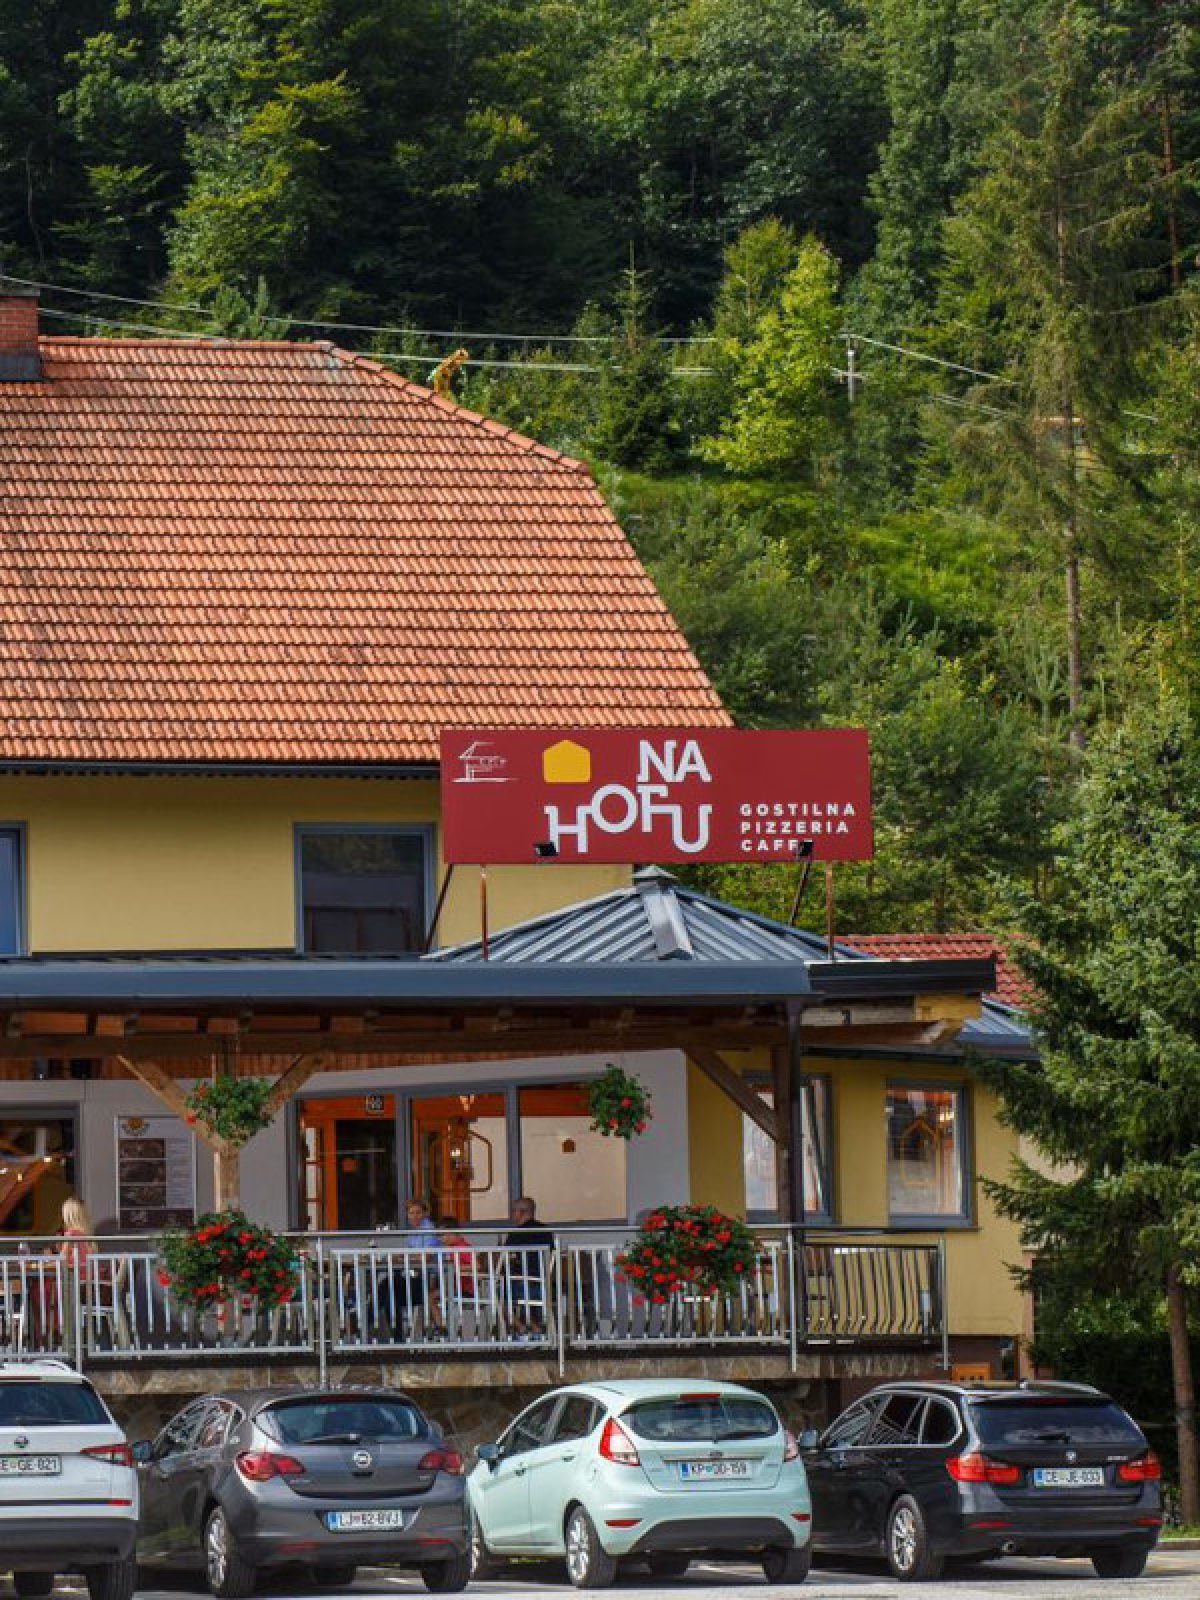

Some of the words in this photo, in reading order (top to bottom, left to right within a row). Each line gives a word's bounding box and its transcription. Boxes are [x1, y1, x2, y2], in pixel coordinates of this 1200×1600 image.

[636, 739, 712, 783] NA
[739, 803, 856, 817] GOSTILNA
[544, 784, 713, 853] HOFU
[739, 821, 849, 835] PIZZERIA
[740, 839, 813, 852] CAFF
[691, 1463, 705, 1475] KP
[1046, 1471, 1059, 1483] CE
[340, 1512, 354, 1526] LJ
